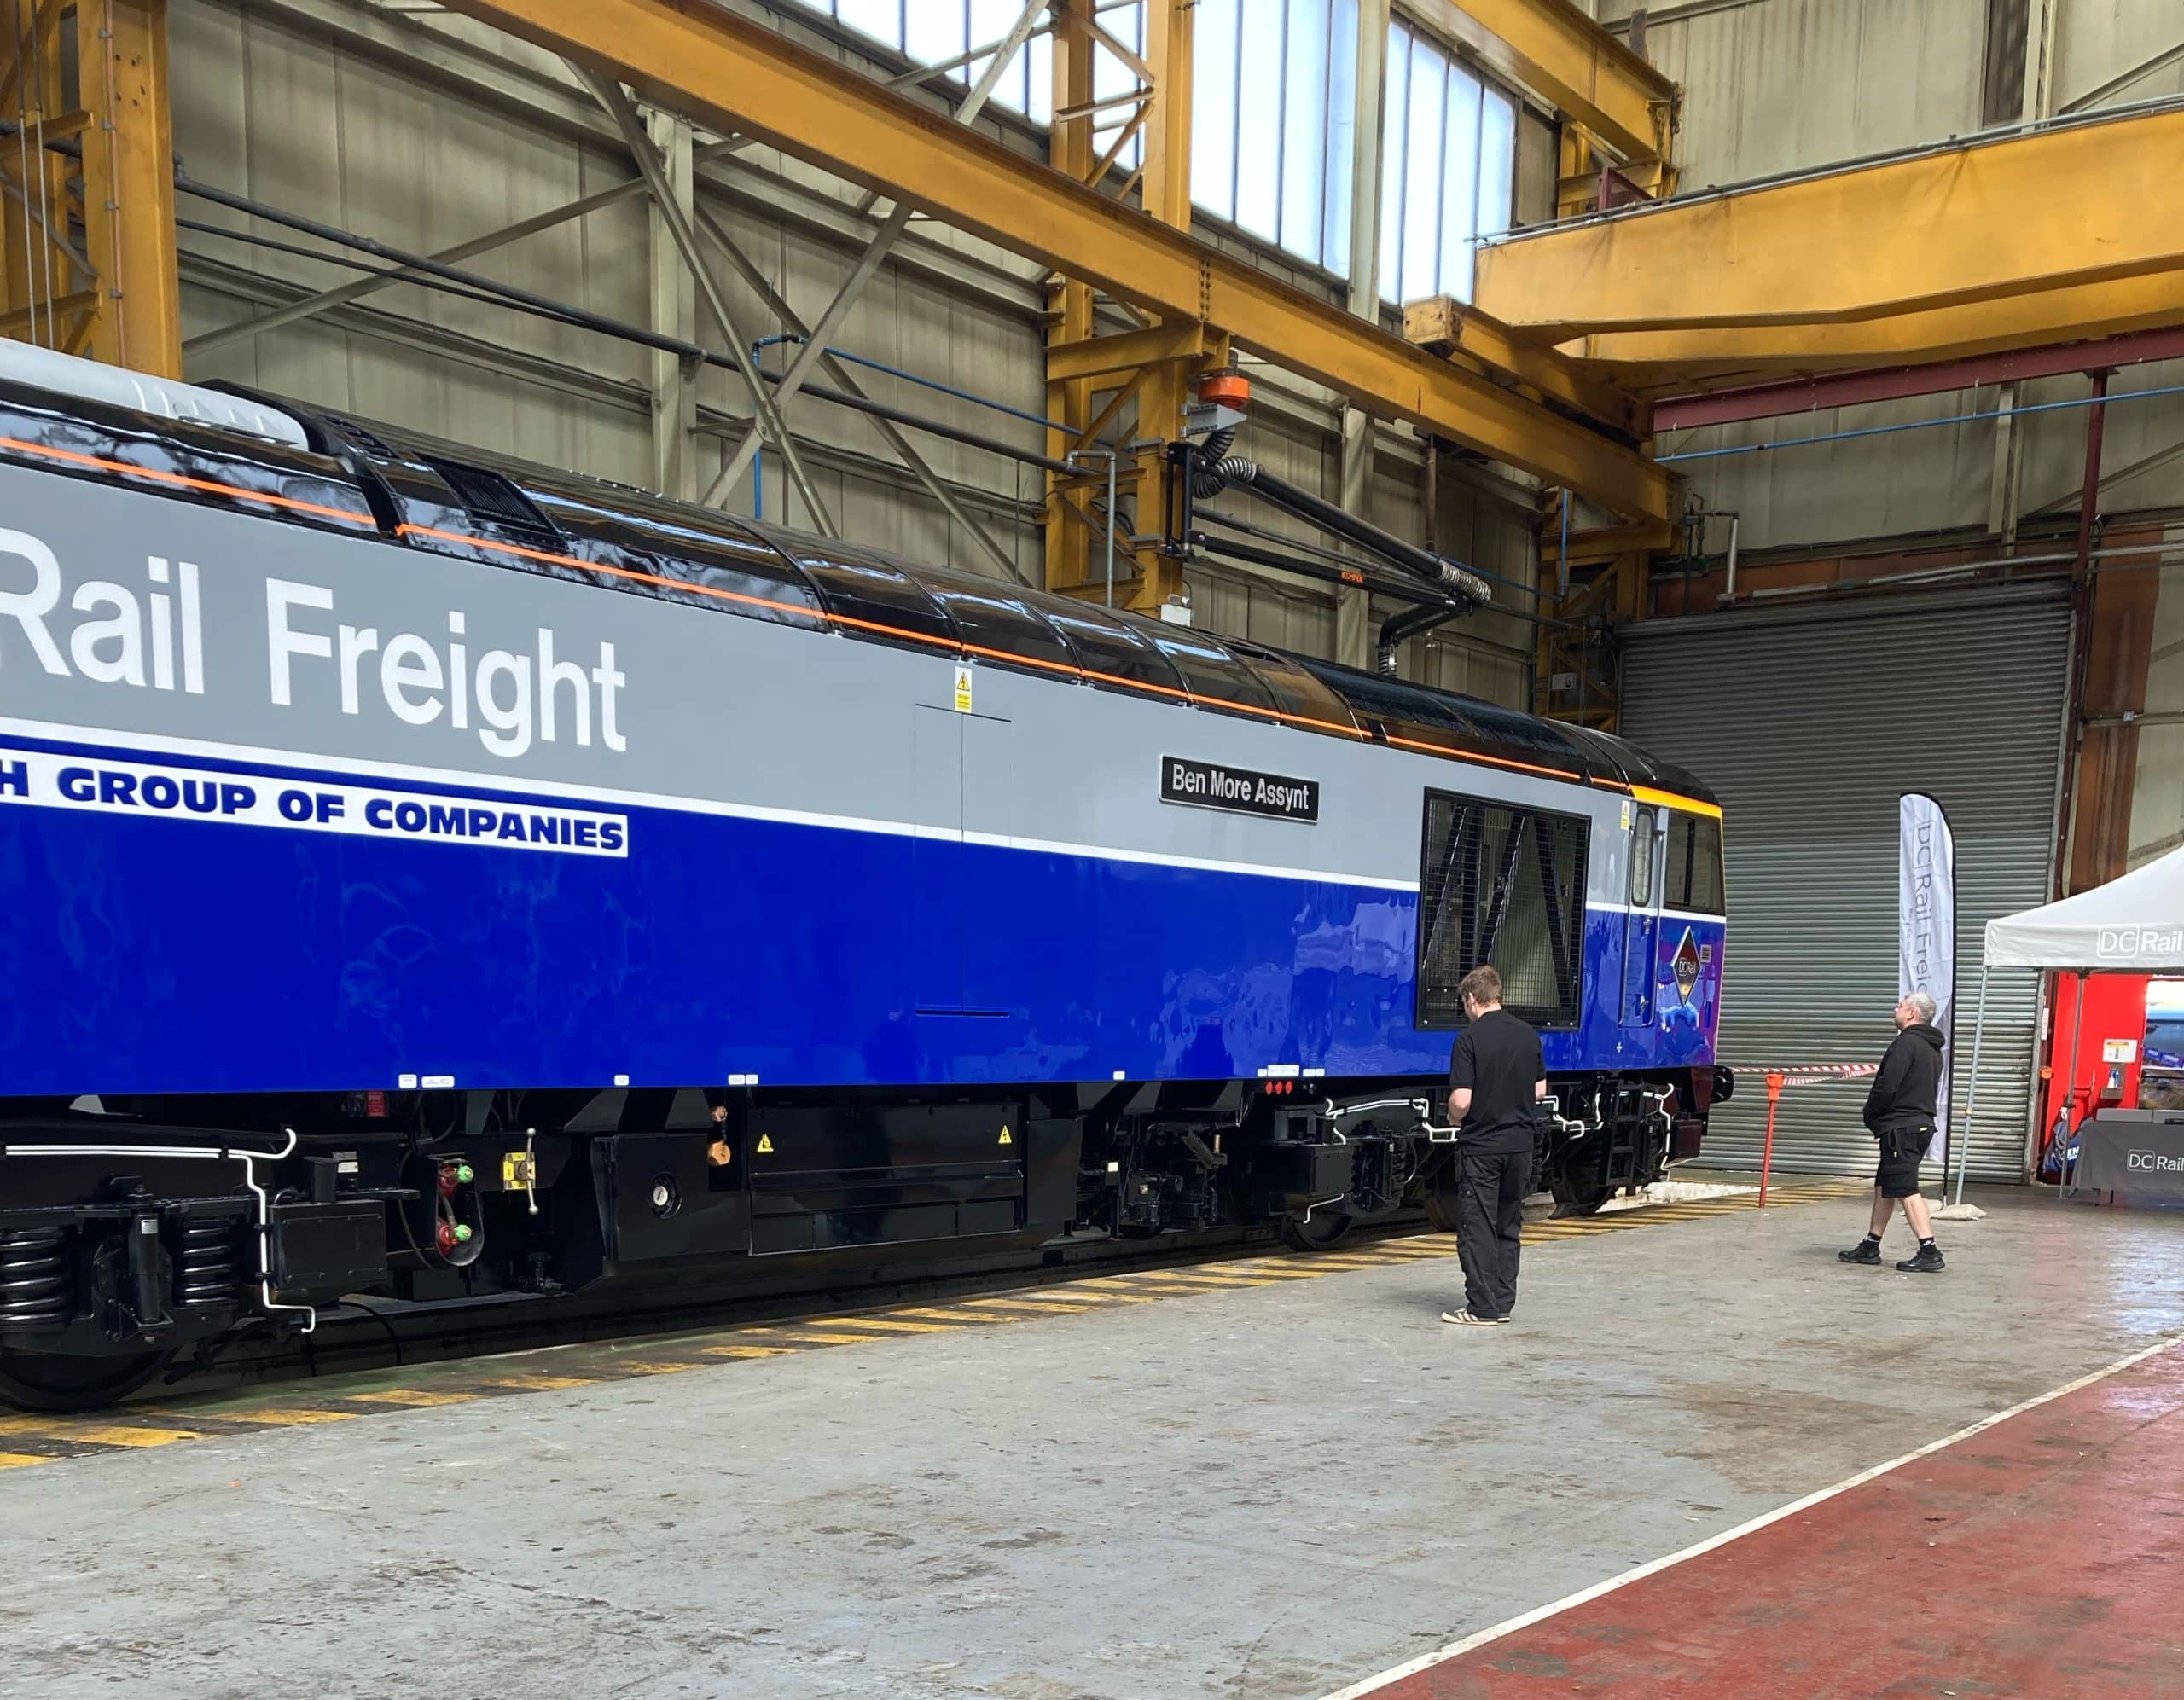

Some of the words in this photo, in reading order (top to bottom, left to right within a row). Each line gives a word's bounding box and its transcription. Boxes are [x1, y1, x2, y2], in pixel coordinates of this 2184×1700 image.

[0, 526, 205, 694] Rail
[265, 577, 626, 757] Freight
[56, 766, 257, 815] GROUP
[277, 789, 346, 823] OF
[364, 799, 624, 850] COMPANIES
[1172, 763, 1205, 794] Ben
[1210, 770, 1252, 801] More
[1254, 777, 1310, 812] Assynt
[1916, 823, 1931, 865] DC
[1915, 874, 1932, 921] Rail
[1916, 932, 1931, 994] Frei
[2100, 931, 2136, 953] DC
[2140, 931, 2184, 953] Rail
[2129, 1153, 2153, 1169] DC
[2156, 1156, 2184, 1172] Rail
